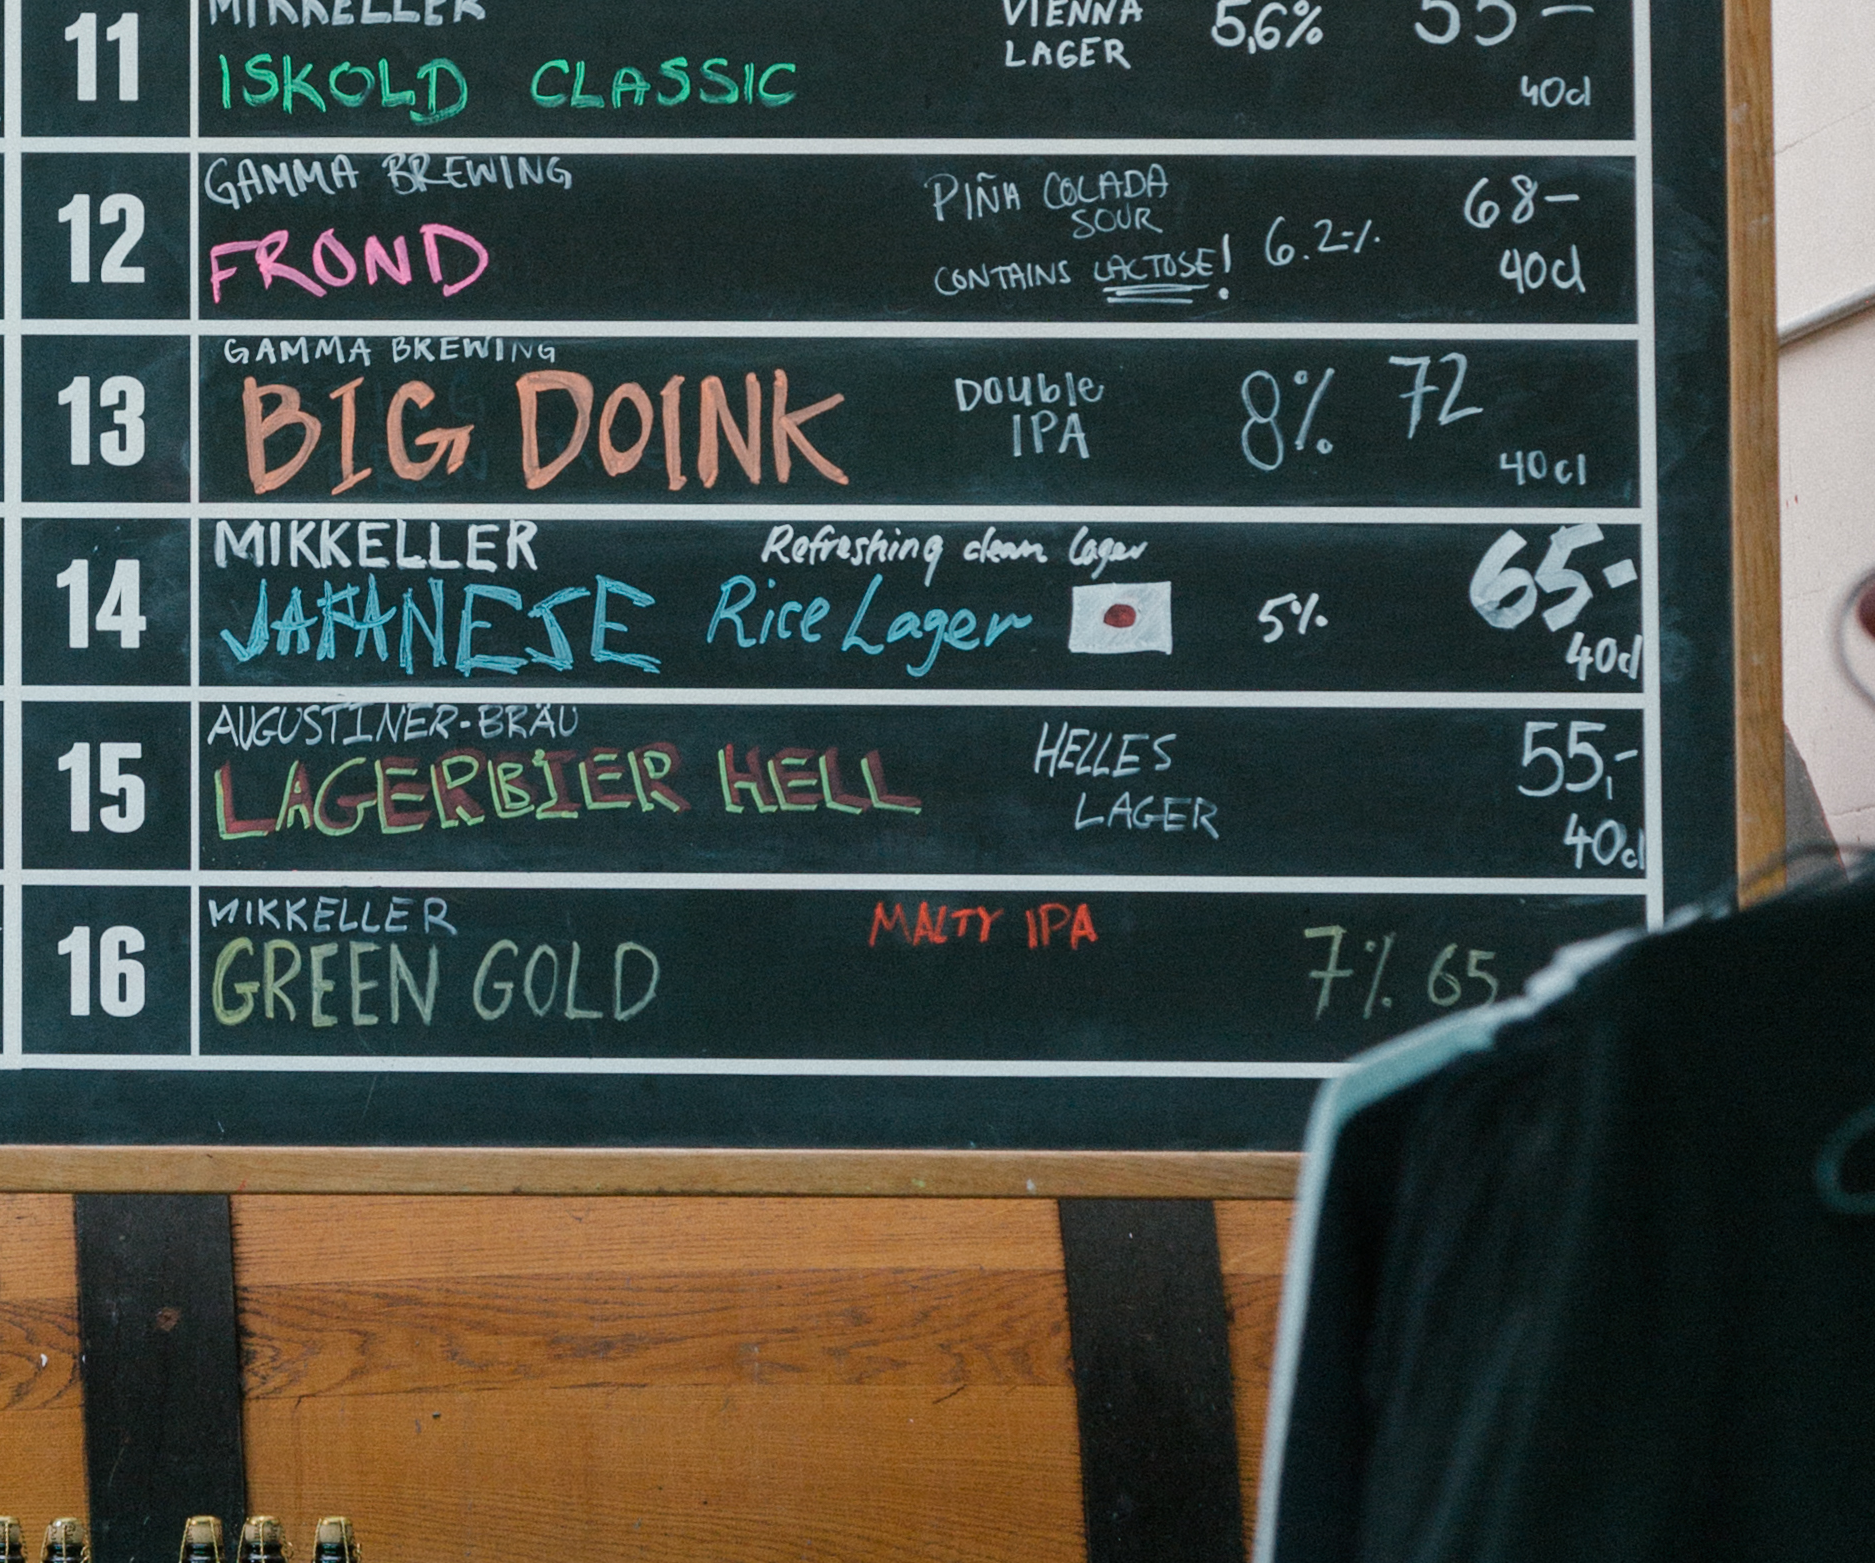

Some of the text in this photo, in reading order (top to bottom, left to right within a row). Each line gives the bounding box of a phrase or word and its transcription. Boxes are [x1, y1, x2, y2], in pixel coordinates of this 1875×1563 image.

[63, 12, 140, 102] 11
[1004, 38, 1131, 70] LAGER
[218, 52, 798, 125] ISKOLD CLASSIC
[203, 152, 573, 209] GAMMA BREWING
[1041, 163, 1169, 209] COLADA
[57, 193, 145, 284] 12
[1072, 206, 1163, 239] SOUR
[211, 223, 489, 304] FROND
[935, 258, 1072, 296] CONTAINS
[223, 334, 557, 365] GAMMA BREWING
[56, 376, 147, 466] 13
[1388, 351, 1484, 440] 72
[243, 368, 850, 497] BIG DOINK
[1012, 410, 1090, 460] IPA
[215, 518, 538, 571] MIKKELLER
[761, 523, 944, 586] Refreshing
[56, 559, 147, 649] 14
[220, 572, 1033, 678] JAPANESE Rice Lager
[206, 703, 580, 748] AUGUSTINER-BRÄU
[1033, 721, 1176, 777] HELLES
[57, 741, 145, 834] 15
[718, 744, 924, 818] HELL
[1072, 791, 1219, 839] LAGER
[209, 895, 458, 935] MIKKELLER
[868, 901, 1099, 950] MALTY IPA
[57, 925, 145, 1017] 16
[211, 935, 659, 1026] GREEN GOLD
